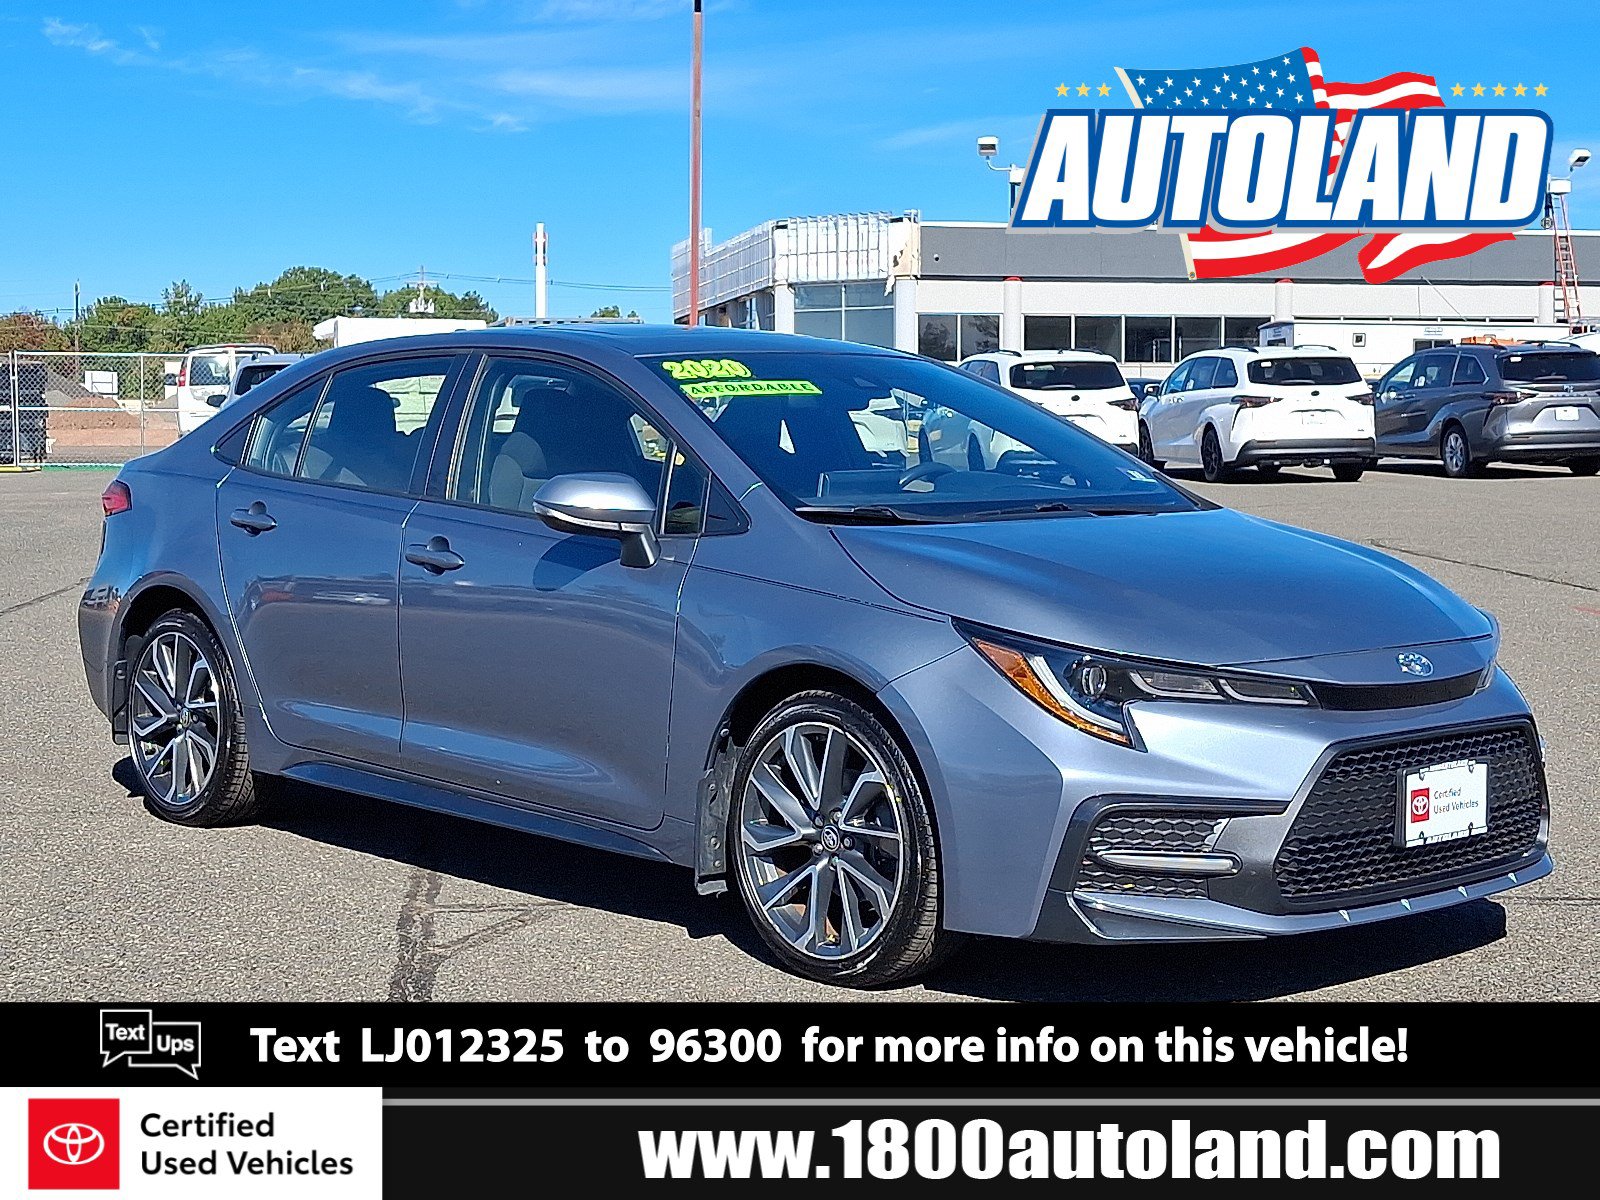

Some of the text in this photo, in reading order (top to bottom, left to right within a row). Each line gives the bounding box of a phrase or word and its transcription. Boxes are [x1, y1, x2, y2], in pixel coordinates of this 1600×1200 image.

[662, 358, 753, 380] 2020
[691, 383, 812, 394] AFFORDABLE
[1433, 799, 1479, 814] Used Vehicles
